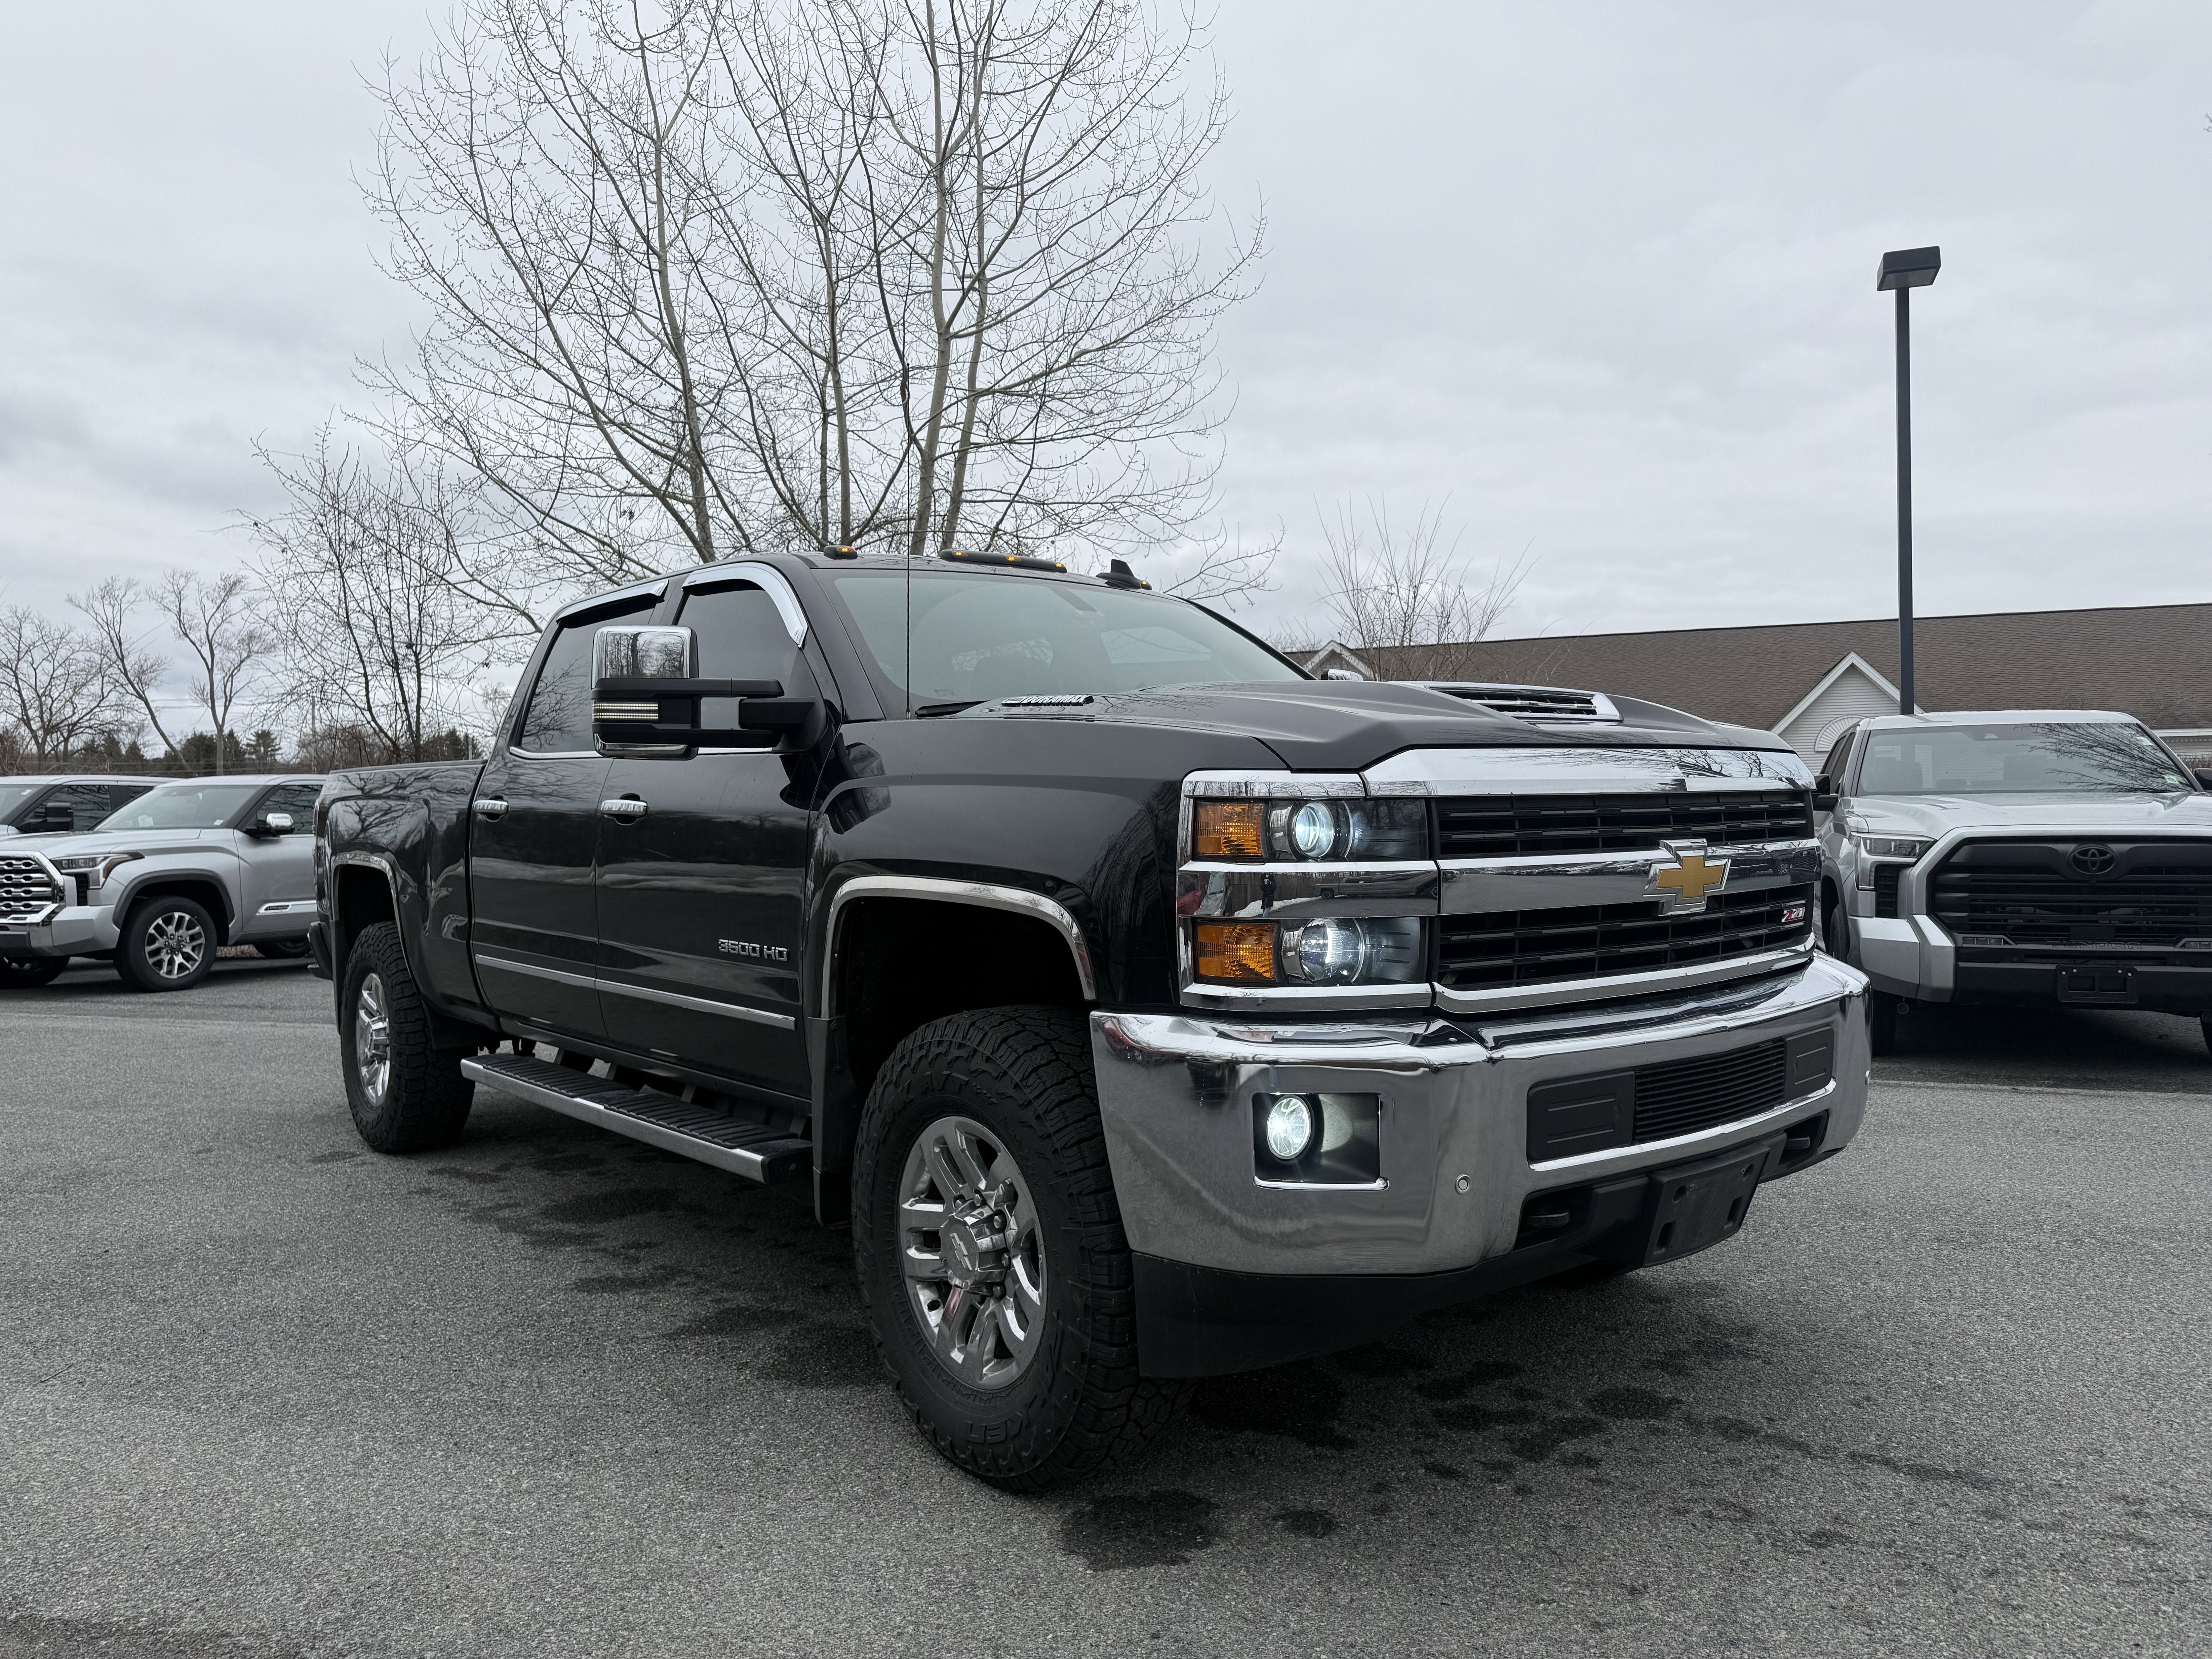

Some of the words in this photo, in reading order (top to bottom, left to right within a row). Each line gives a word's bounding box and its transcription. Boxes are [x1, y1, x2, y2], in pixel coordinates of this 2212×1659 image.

[1021, 695, 1086, 704] DURAMAX
[1781, 907, 1805, 922] Z71
[718, 939, 760, 957] 3500
[763, 945, 788, 962] HD
[2046, 941, 2142, 950] TUNDRA
